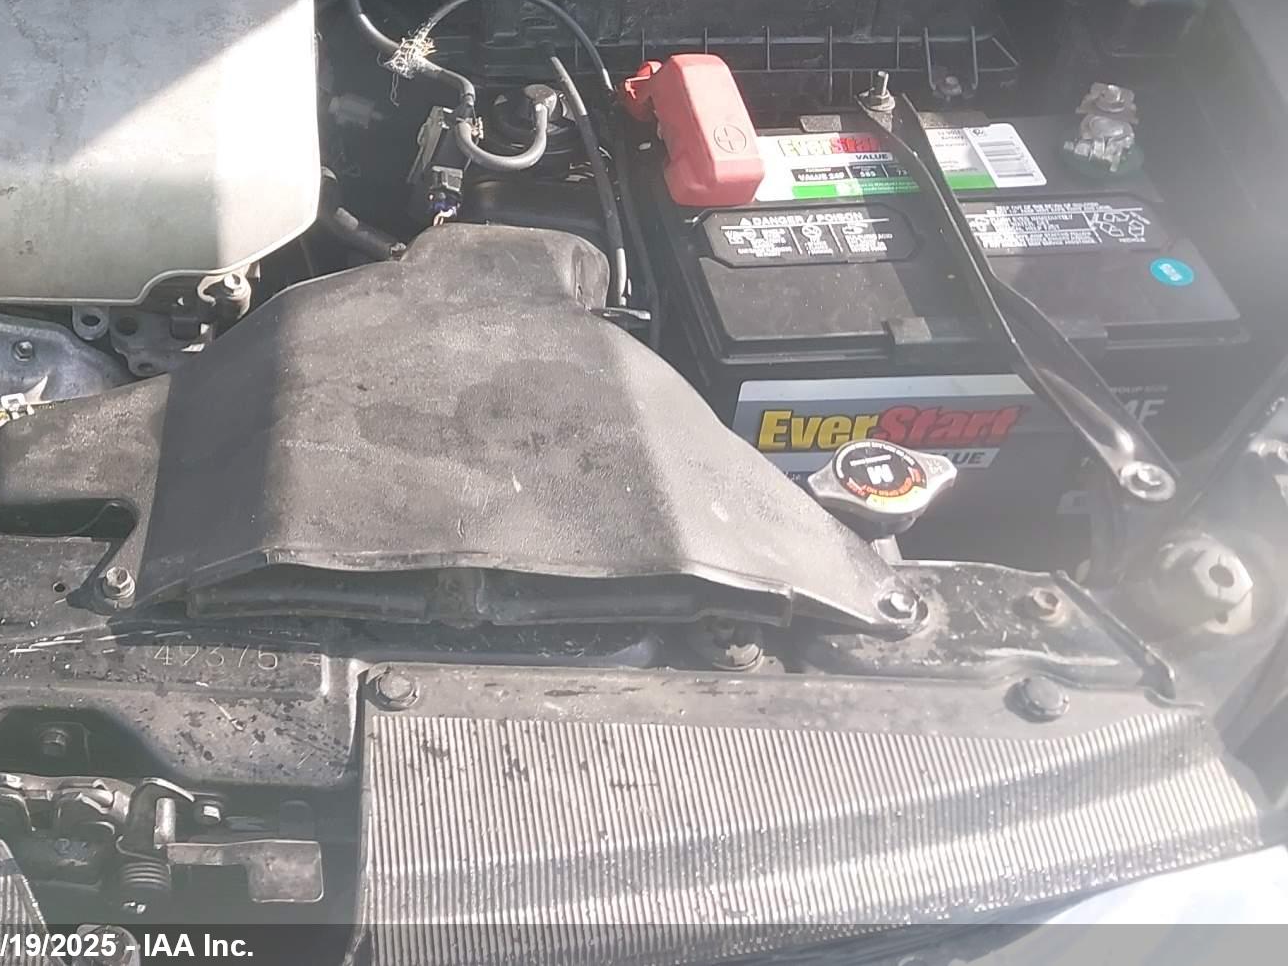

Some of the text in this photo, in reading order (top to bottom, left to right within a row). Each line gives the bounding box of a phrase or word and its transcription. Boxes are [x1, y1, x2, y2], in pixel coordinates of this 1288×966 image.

[855, 153, 889, 161] VALUE
[753, 215, 804, 226] DANGER
[816, 211, 863, 223] POISON
[757, 405, 1019, 451] EverStart
